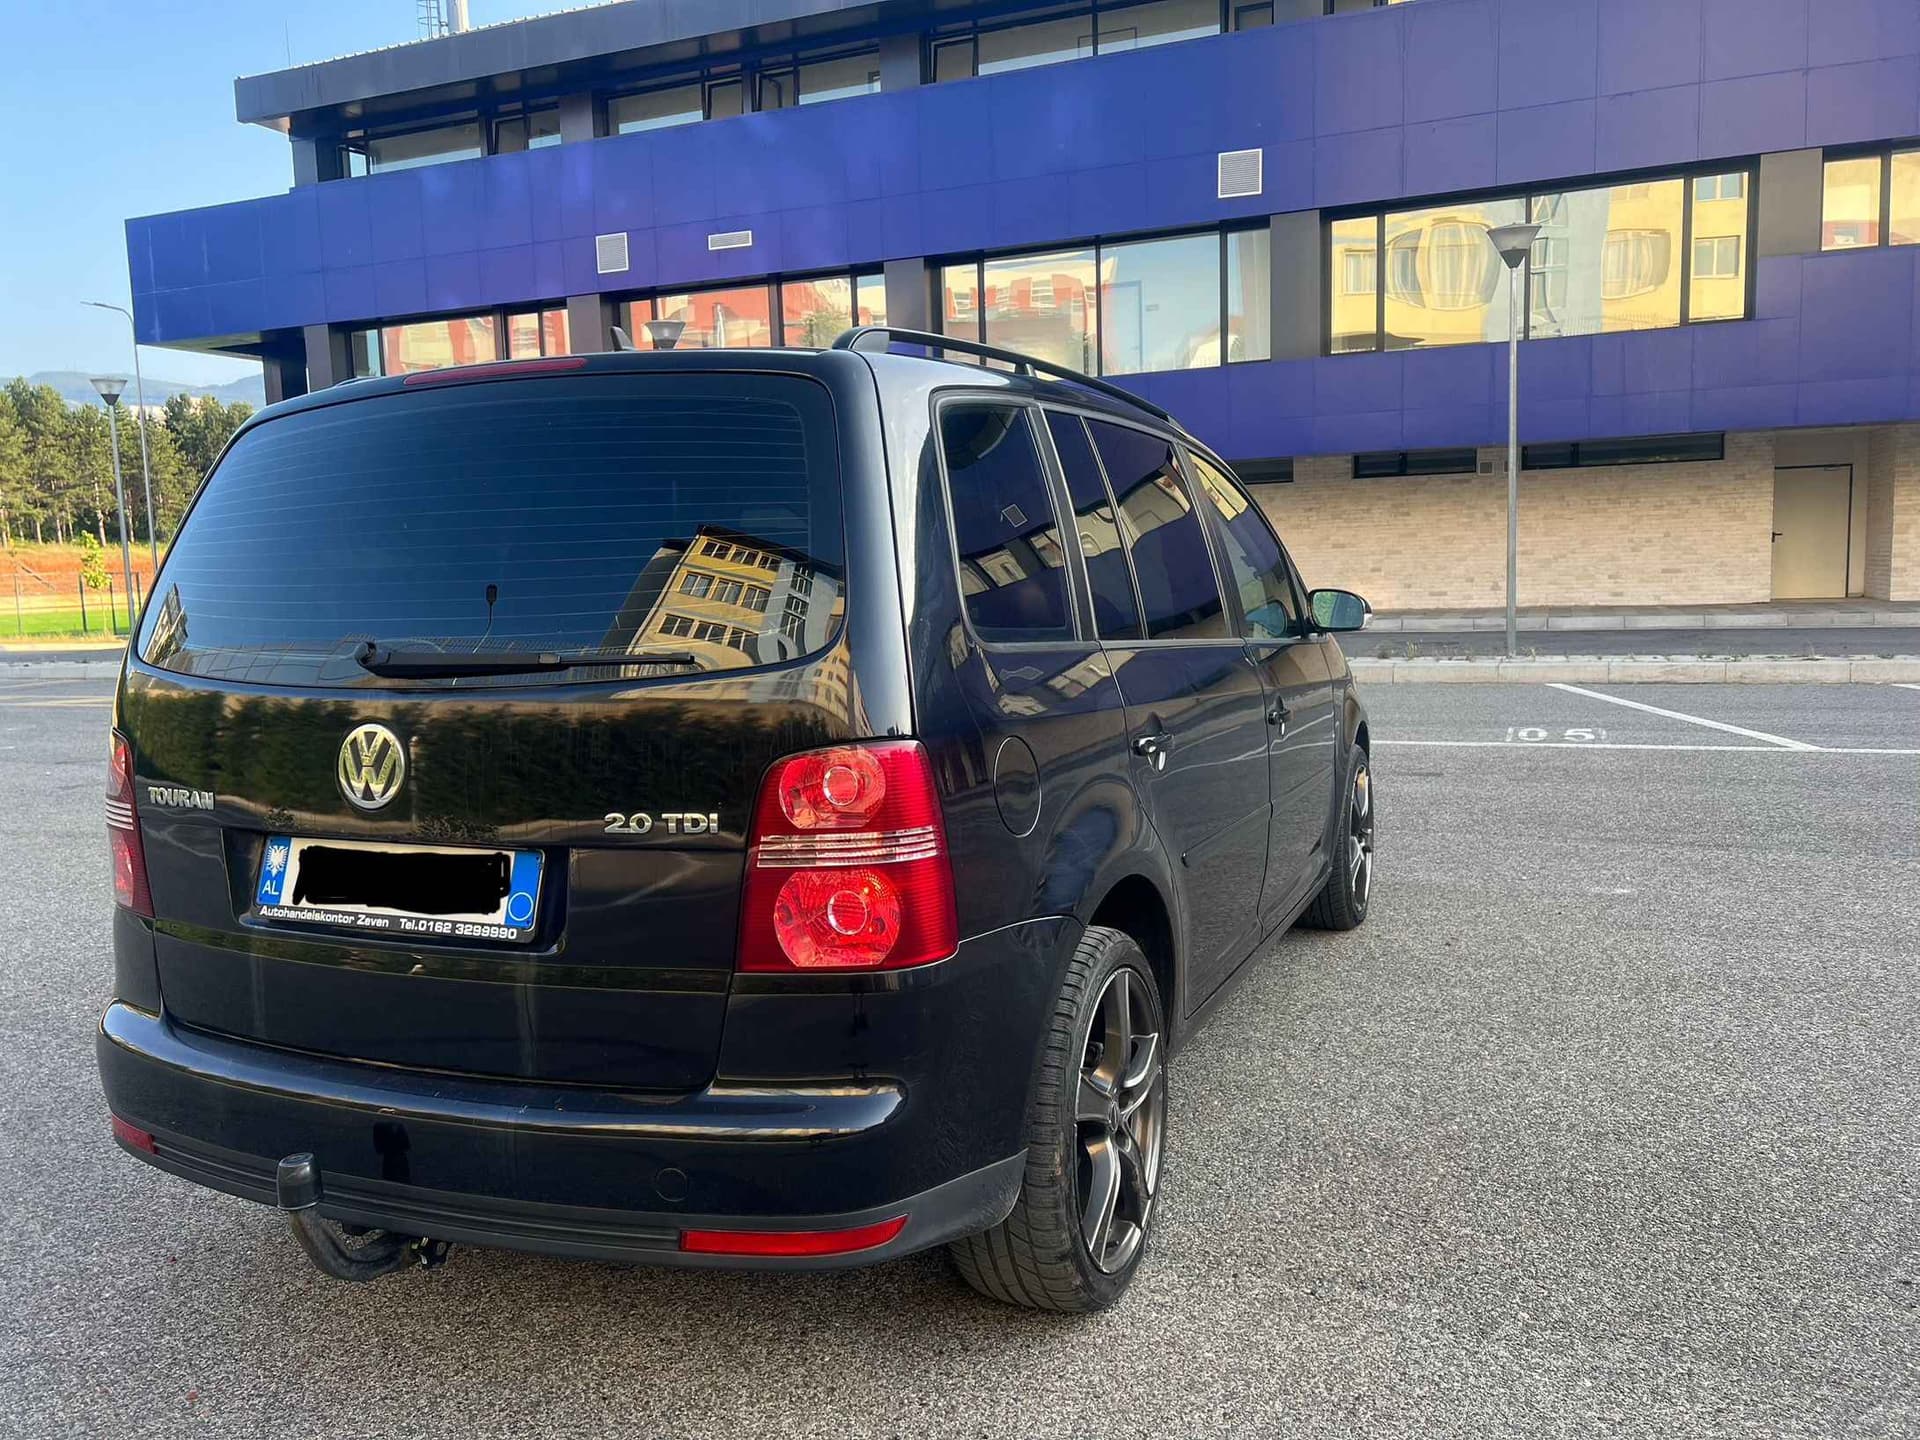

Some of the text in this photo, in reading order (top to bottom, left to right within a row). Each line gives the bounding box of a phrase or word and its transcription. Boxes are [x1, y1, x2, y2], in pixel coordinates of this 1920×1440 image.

[339, 724, 405, 809] VW
[148, 786, 214, 810] TOURAN
[661, 813, 719, 834] TDI
[262, 879, 280, 895] AL
[259, 905, 355, 924] Autohandelskontor
[356, 914, 390, 928] Zeven
[399, 918, 451, 933] Tel.0162
